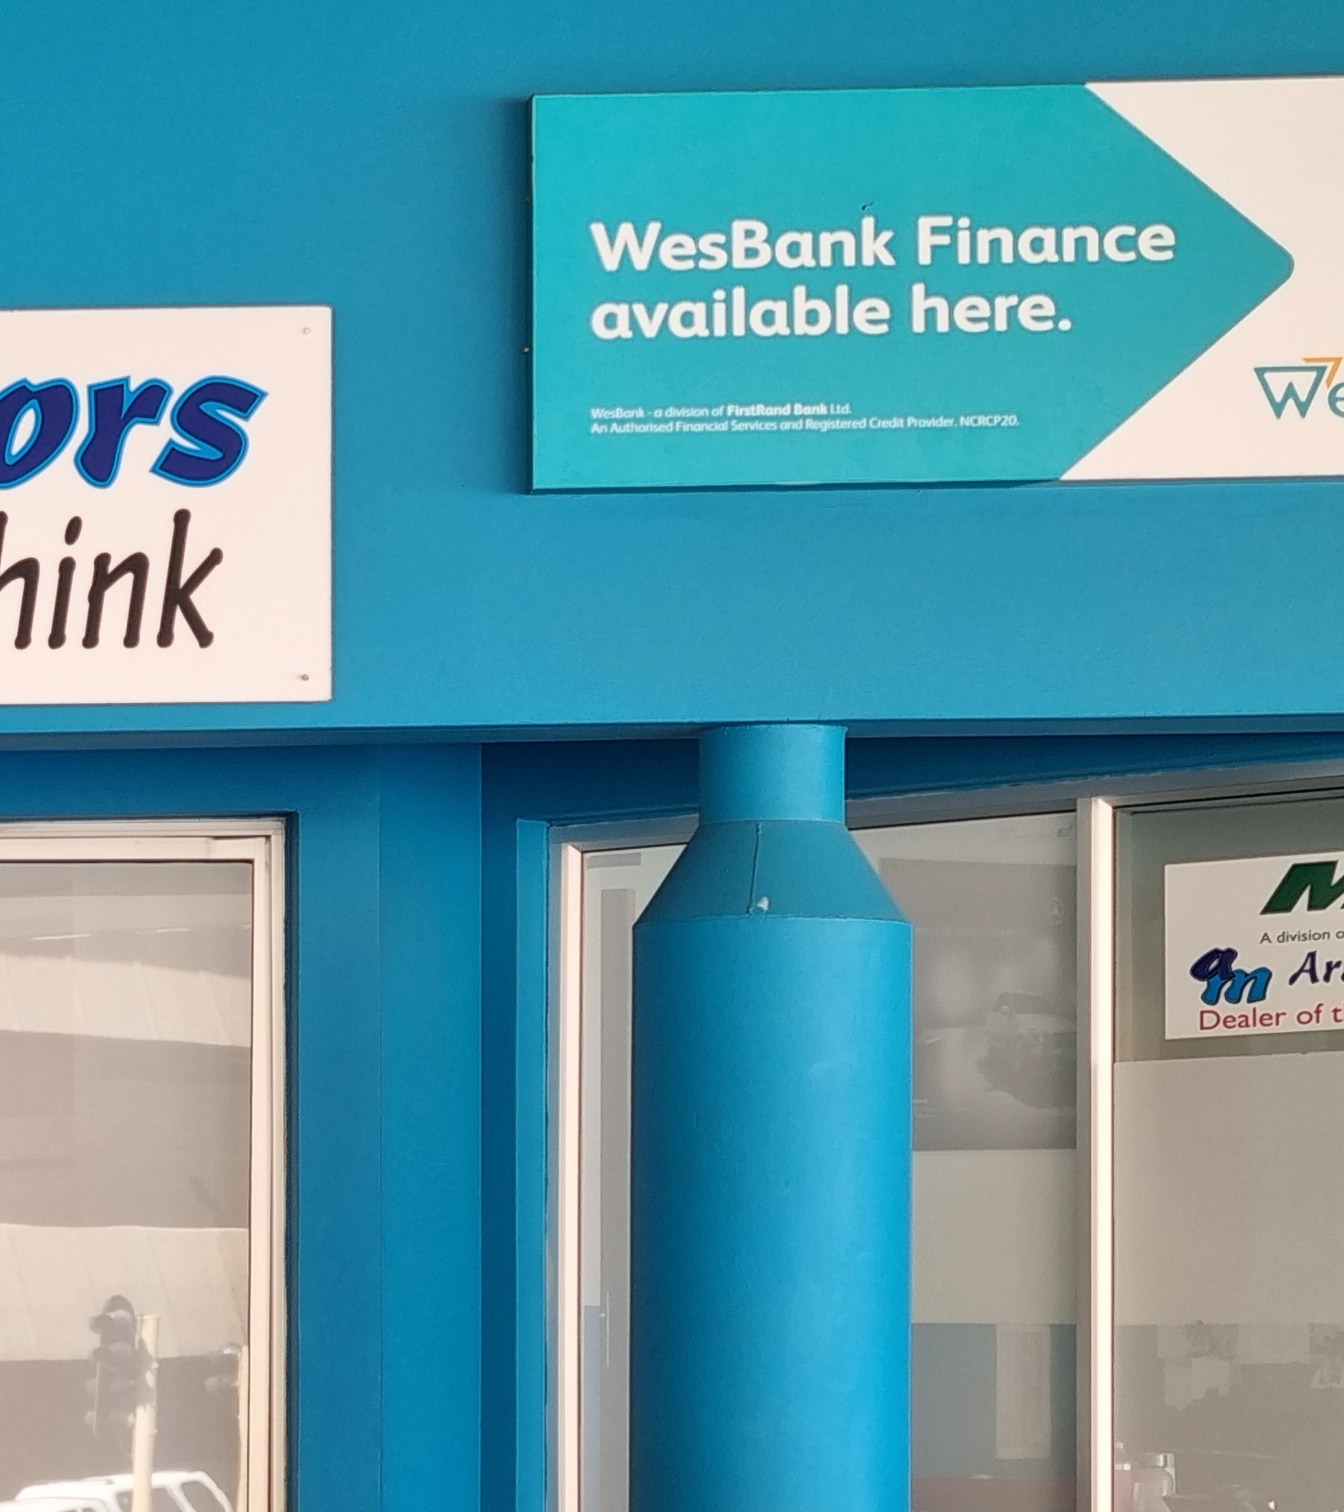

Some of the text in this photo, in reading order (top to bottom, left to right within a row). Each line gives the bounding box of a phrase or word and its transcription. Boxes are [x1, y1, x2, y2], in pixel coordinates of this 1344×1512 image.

[590, 214, 1177, 272] WesBank Finance
[590, 283, 1073, 340] available here.
[591, 407, 645, 419] WesBank
[654, 409, 662, 418] a
[665, 406, 709, 418] division
[712, 405, 725, 416] of
[727, 403, 791, 417] FirstRand
[793, 402, 828, 415] Bank
[830, 403, 852, 415] Ltd.
[591, 422, 607, 434] An
[609, 421, 673, 433] Authorised
[676, 420, 728, 432] Financial
[731, 419, 777, 431] Services
[780, 419, 803, 430] and
[806, 417, 866, 432] Registered
[869, 416, 904, 428] Credit
[1259, 933, 1272, 944] A
[1276, 929, 1331, 944] division
[1288, 950, 1344, 987] Ar
[1199, 1006, 1287, 1031] Dealer
[1296, 1002, 1325, 1025] of
